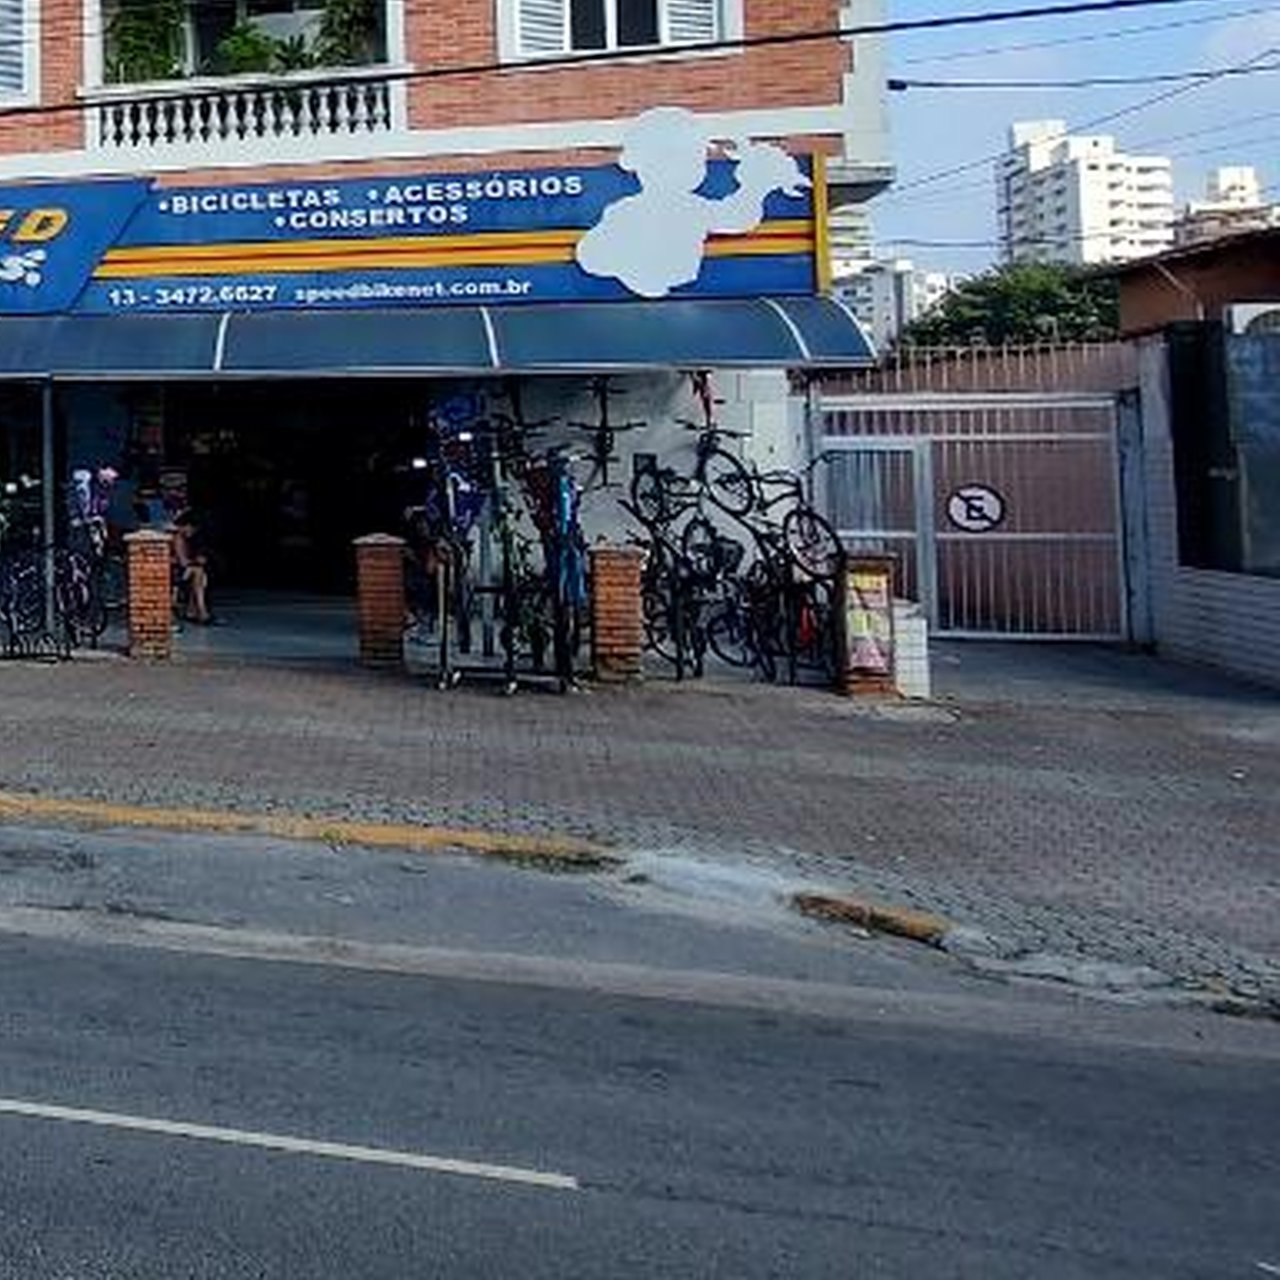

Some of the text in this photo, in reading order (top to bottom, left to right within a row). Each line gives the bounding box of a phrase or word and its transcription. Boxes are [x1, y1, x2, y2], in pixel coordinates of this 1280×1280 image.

[171, 173, 583, 214] BICICLETAS ACESSÓRIOS
[289, 203, 469, 229] CONSERTOS
